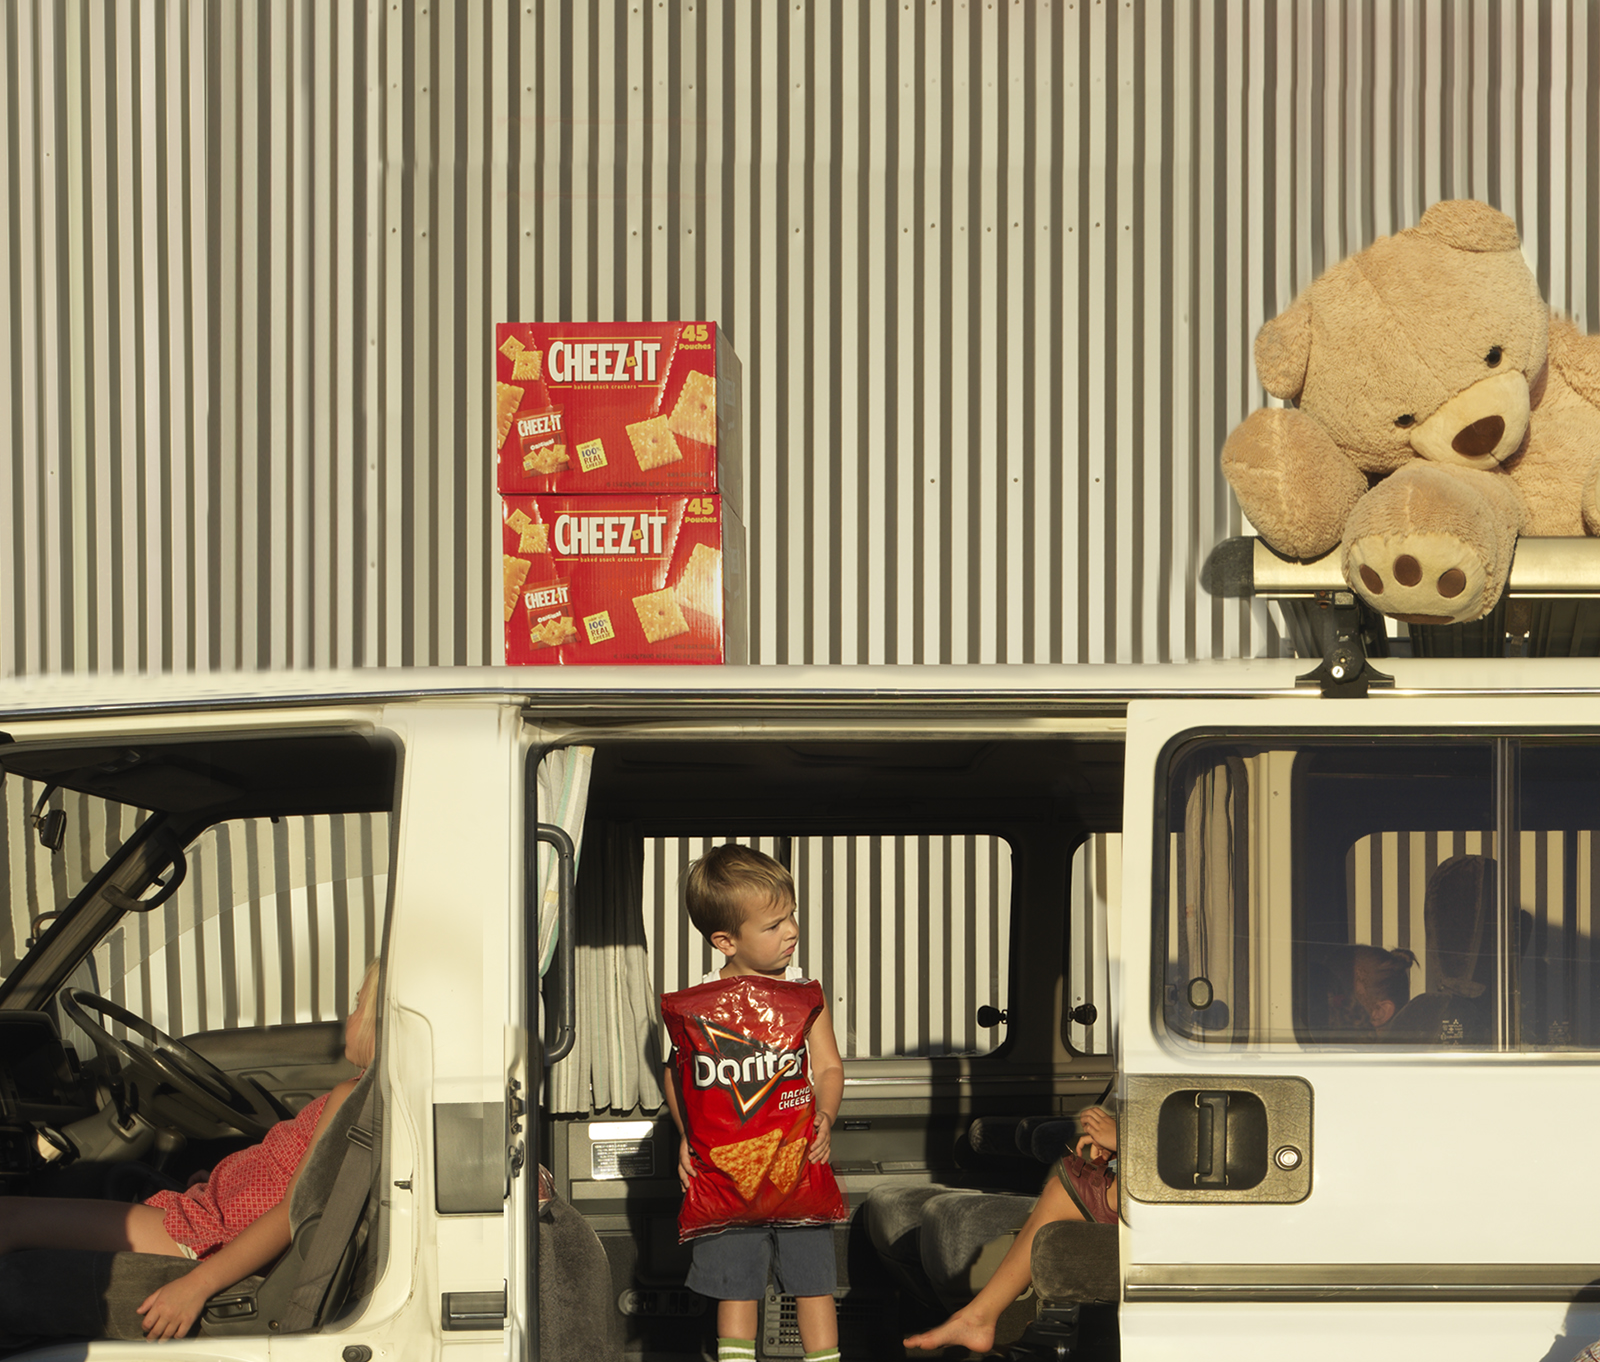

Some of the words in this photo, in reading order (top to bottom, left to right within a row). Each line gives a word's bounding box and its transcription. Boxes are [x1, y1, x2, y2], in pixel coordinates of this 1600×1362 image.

[682, 325, 709, 342] 45
[584, 454, 603, 465] REAL
[687, 498, 714, 515] 45
[591, 626, 610, 638] REAL
[781, 1086, 811, 1100] NACHO
[779, 1094, 811, 1110] CHEESE
